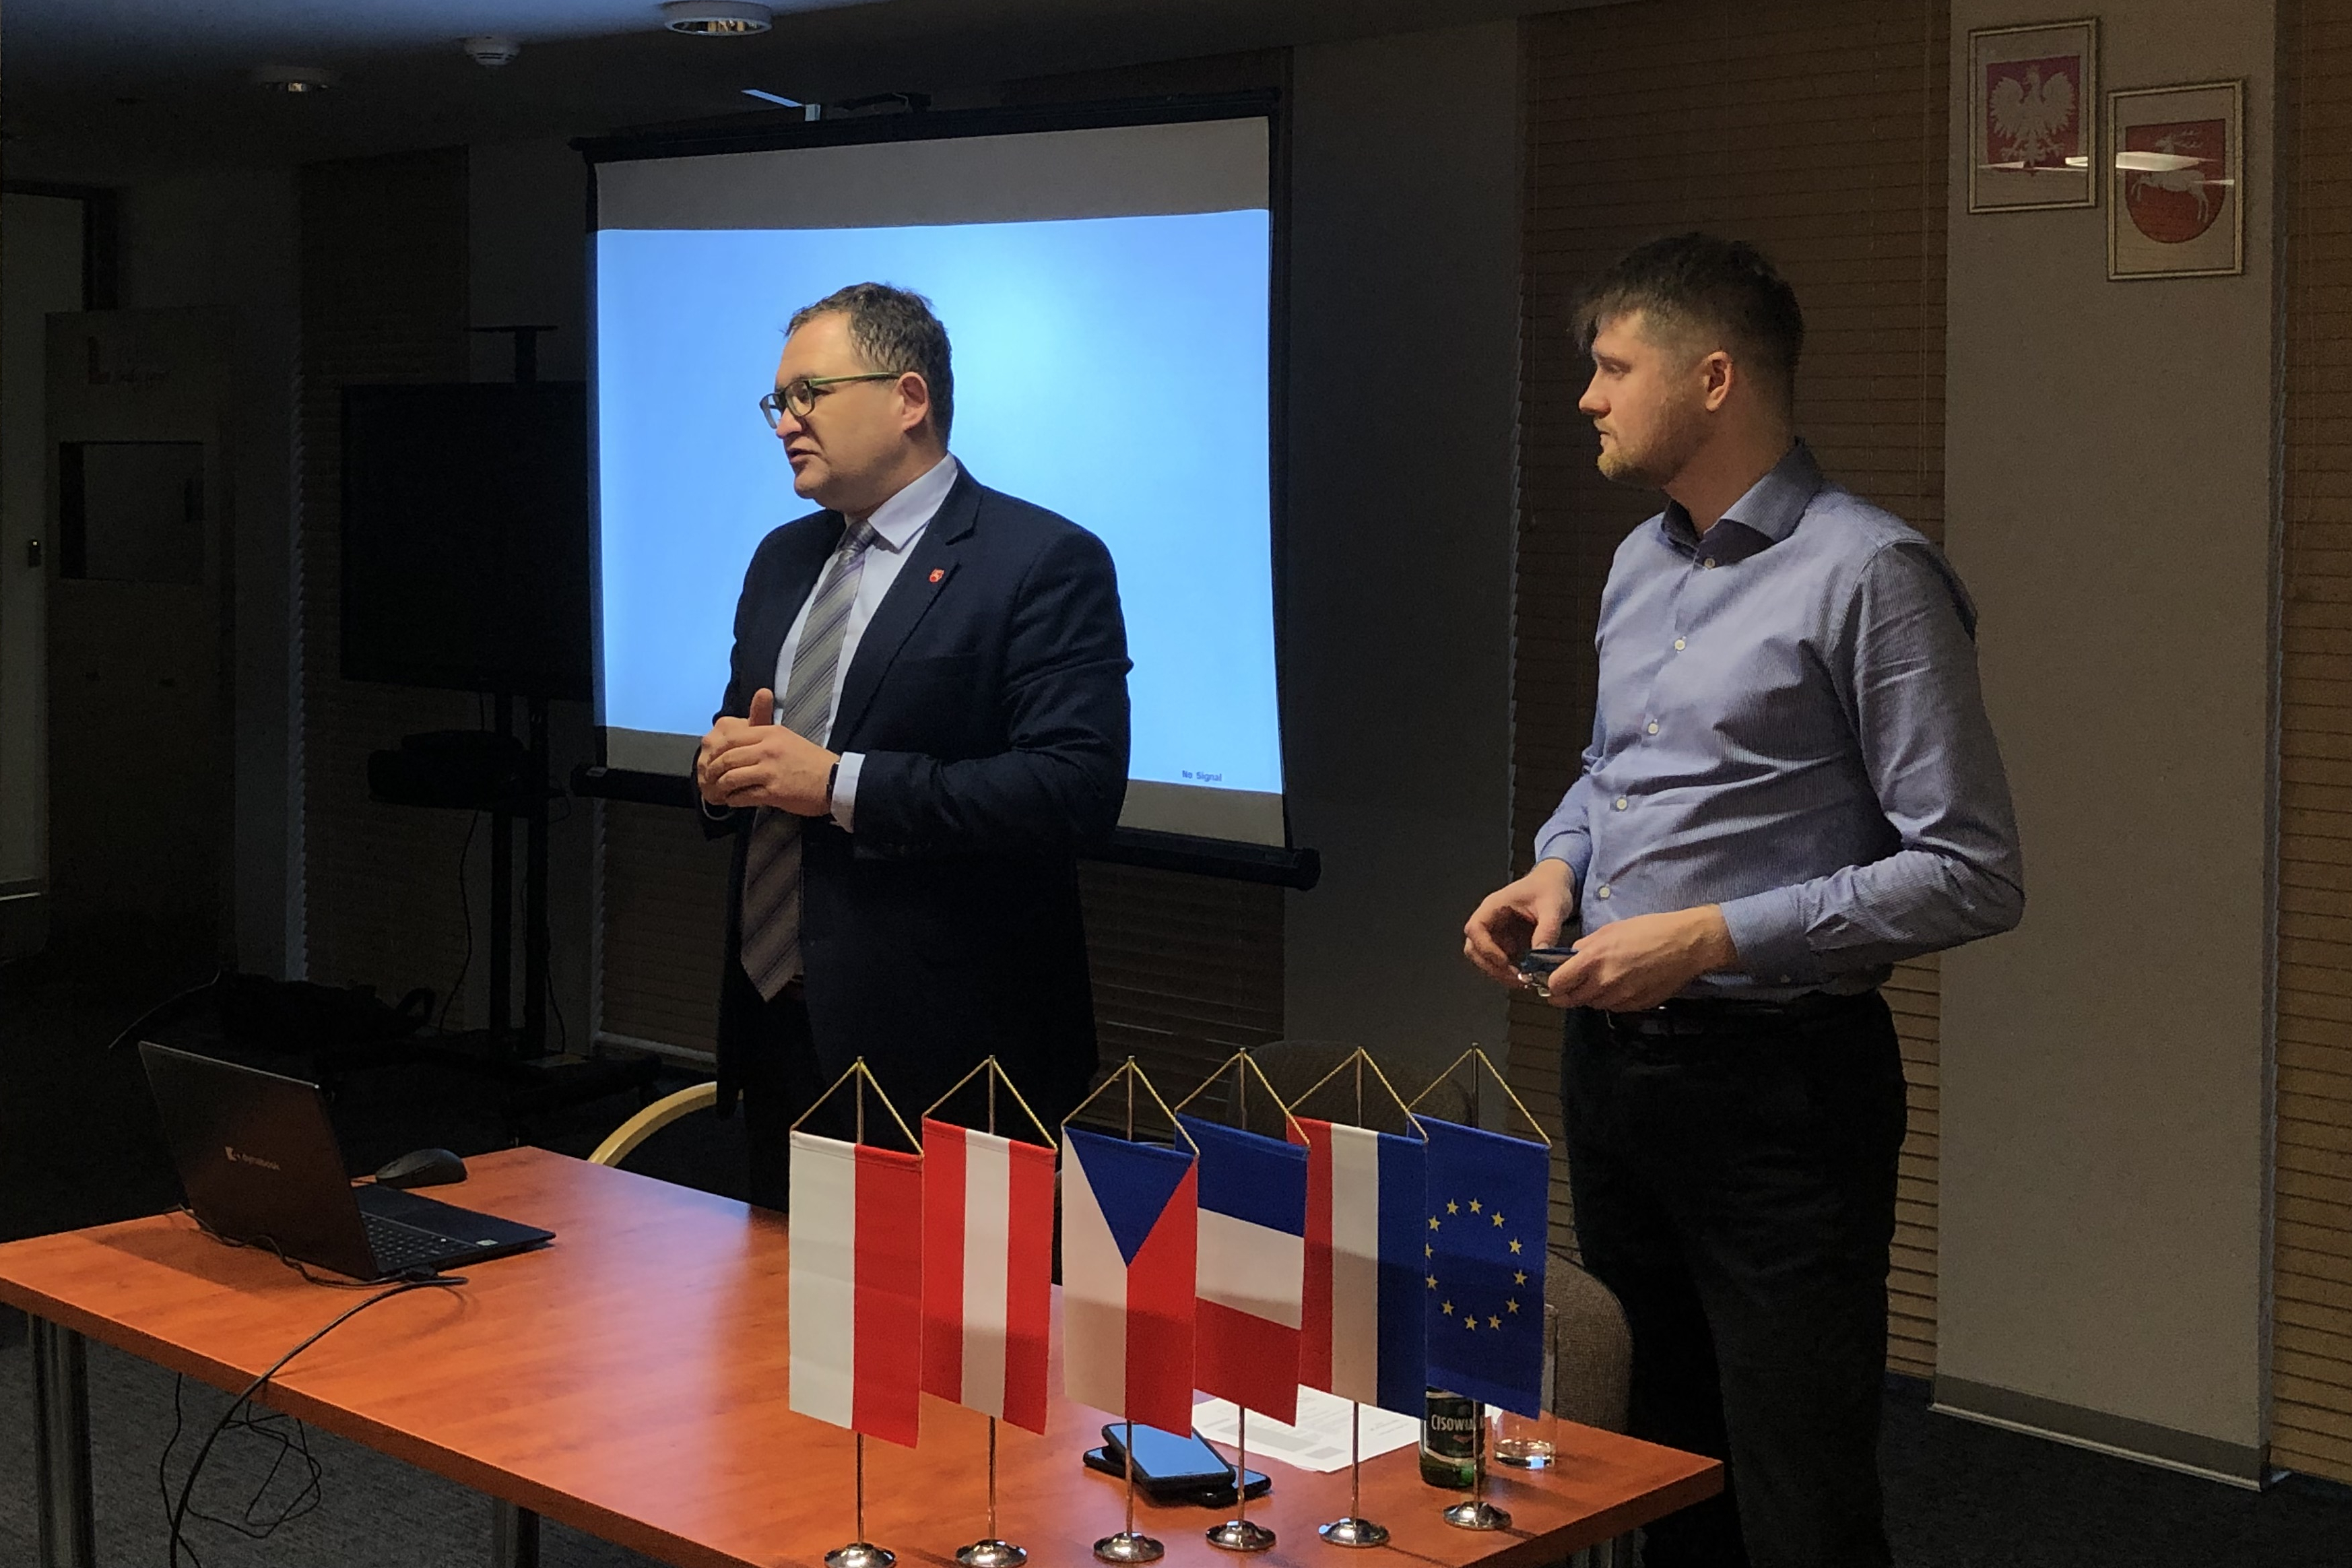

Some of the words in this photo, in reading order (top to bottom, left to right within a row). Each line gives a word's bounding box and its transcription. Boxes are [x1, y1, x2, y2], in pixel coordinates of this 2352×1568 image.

[1182, 770, 1193, 779] No
[1196, 771, 1222, 782] Signal
[1431, 1414, 1484, 1431] CISOWIA
